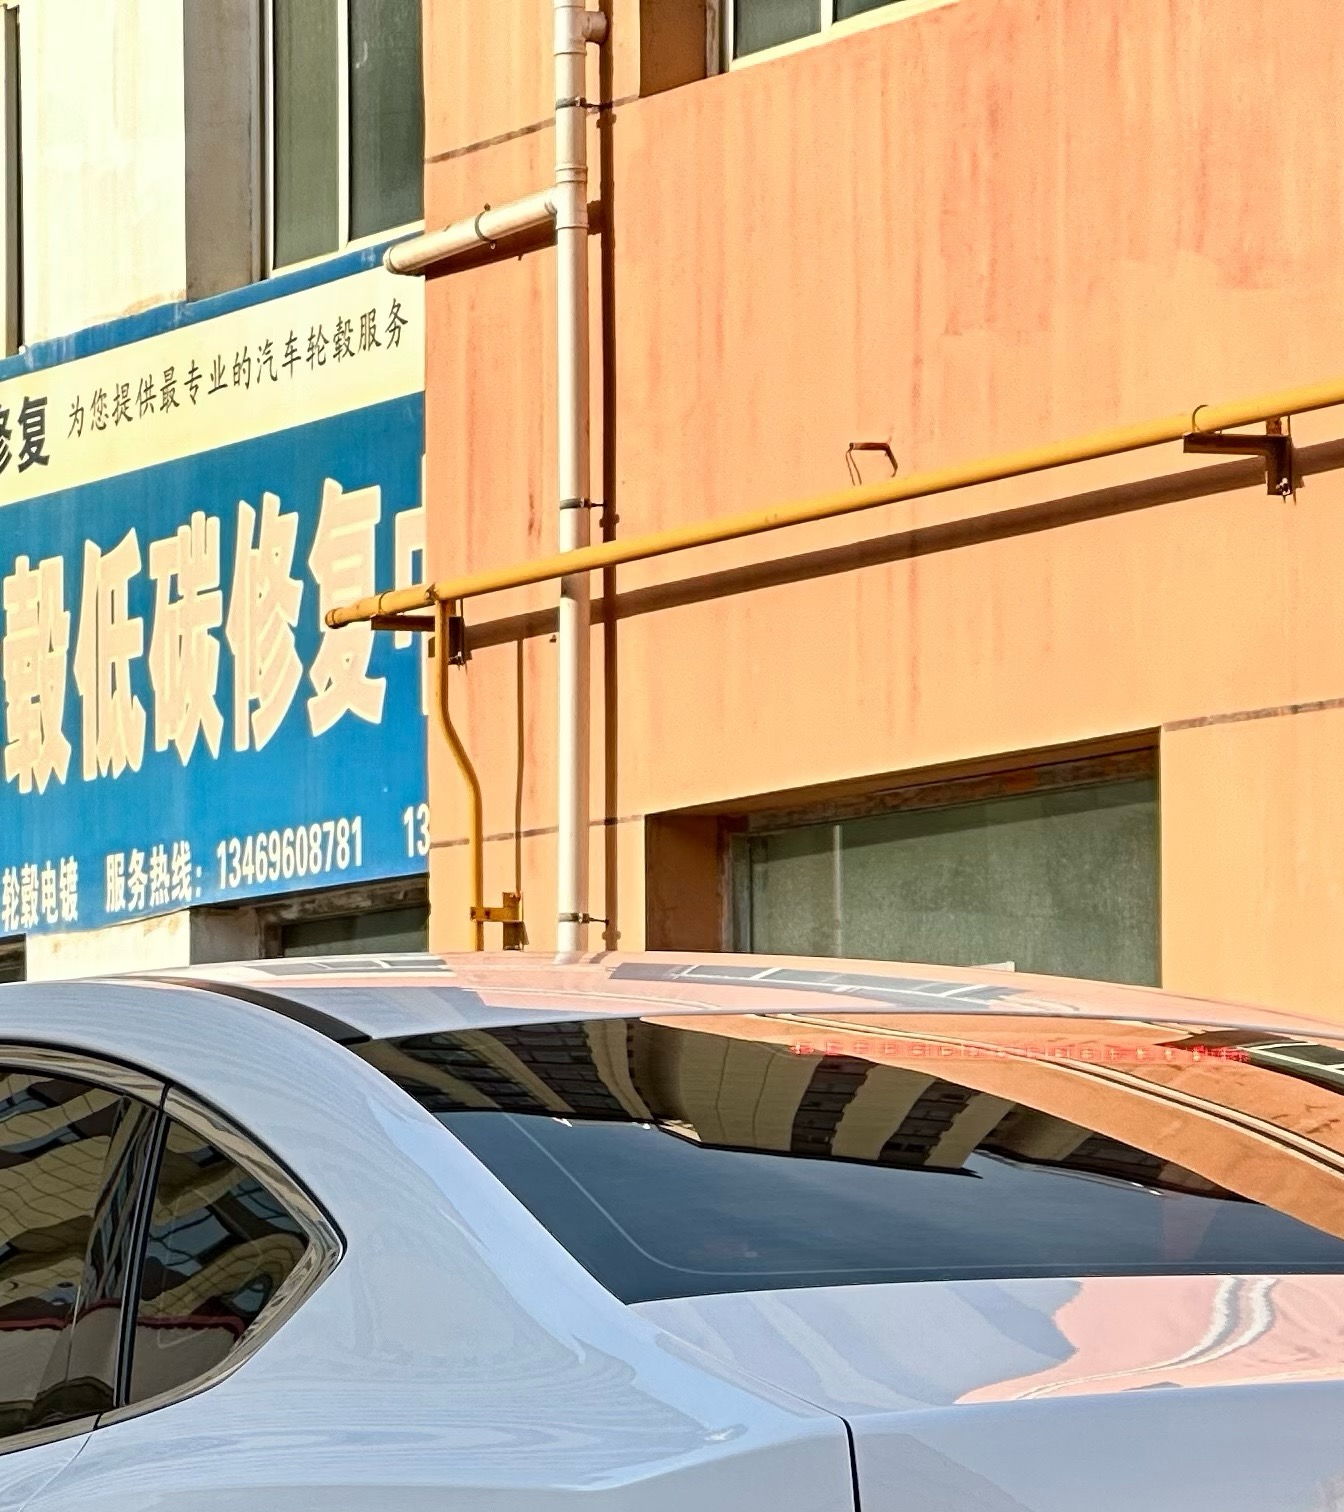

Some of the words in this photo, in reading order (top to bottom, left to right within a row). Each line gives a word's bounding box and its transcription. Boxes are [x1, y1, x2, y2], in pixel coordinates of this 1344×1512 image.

[66, 297, 409, 440] 为您提供最专业的汽车轮毂服务
[1, 855, 78, 933] 轮毂电镀
